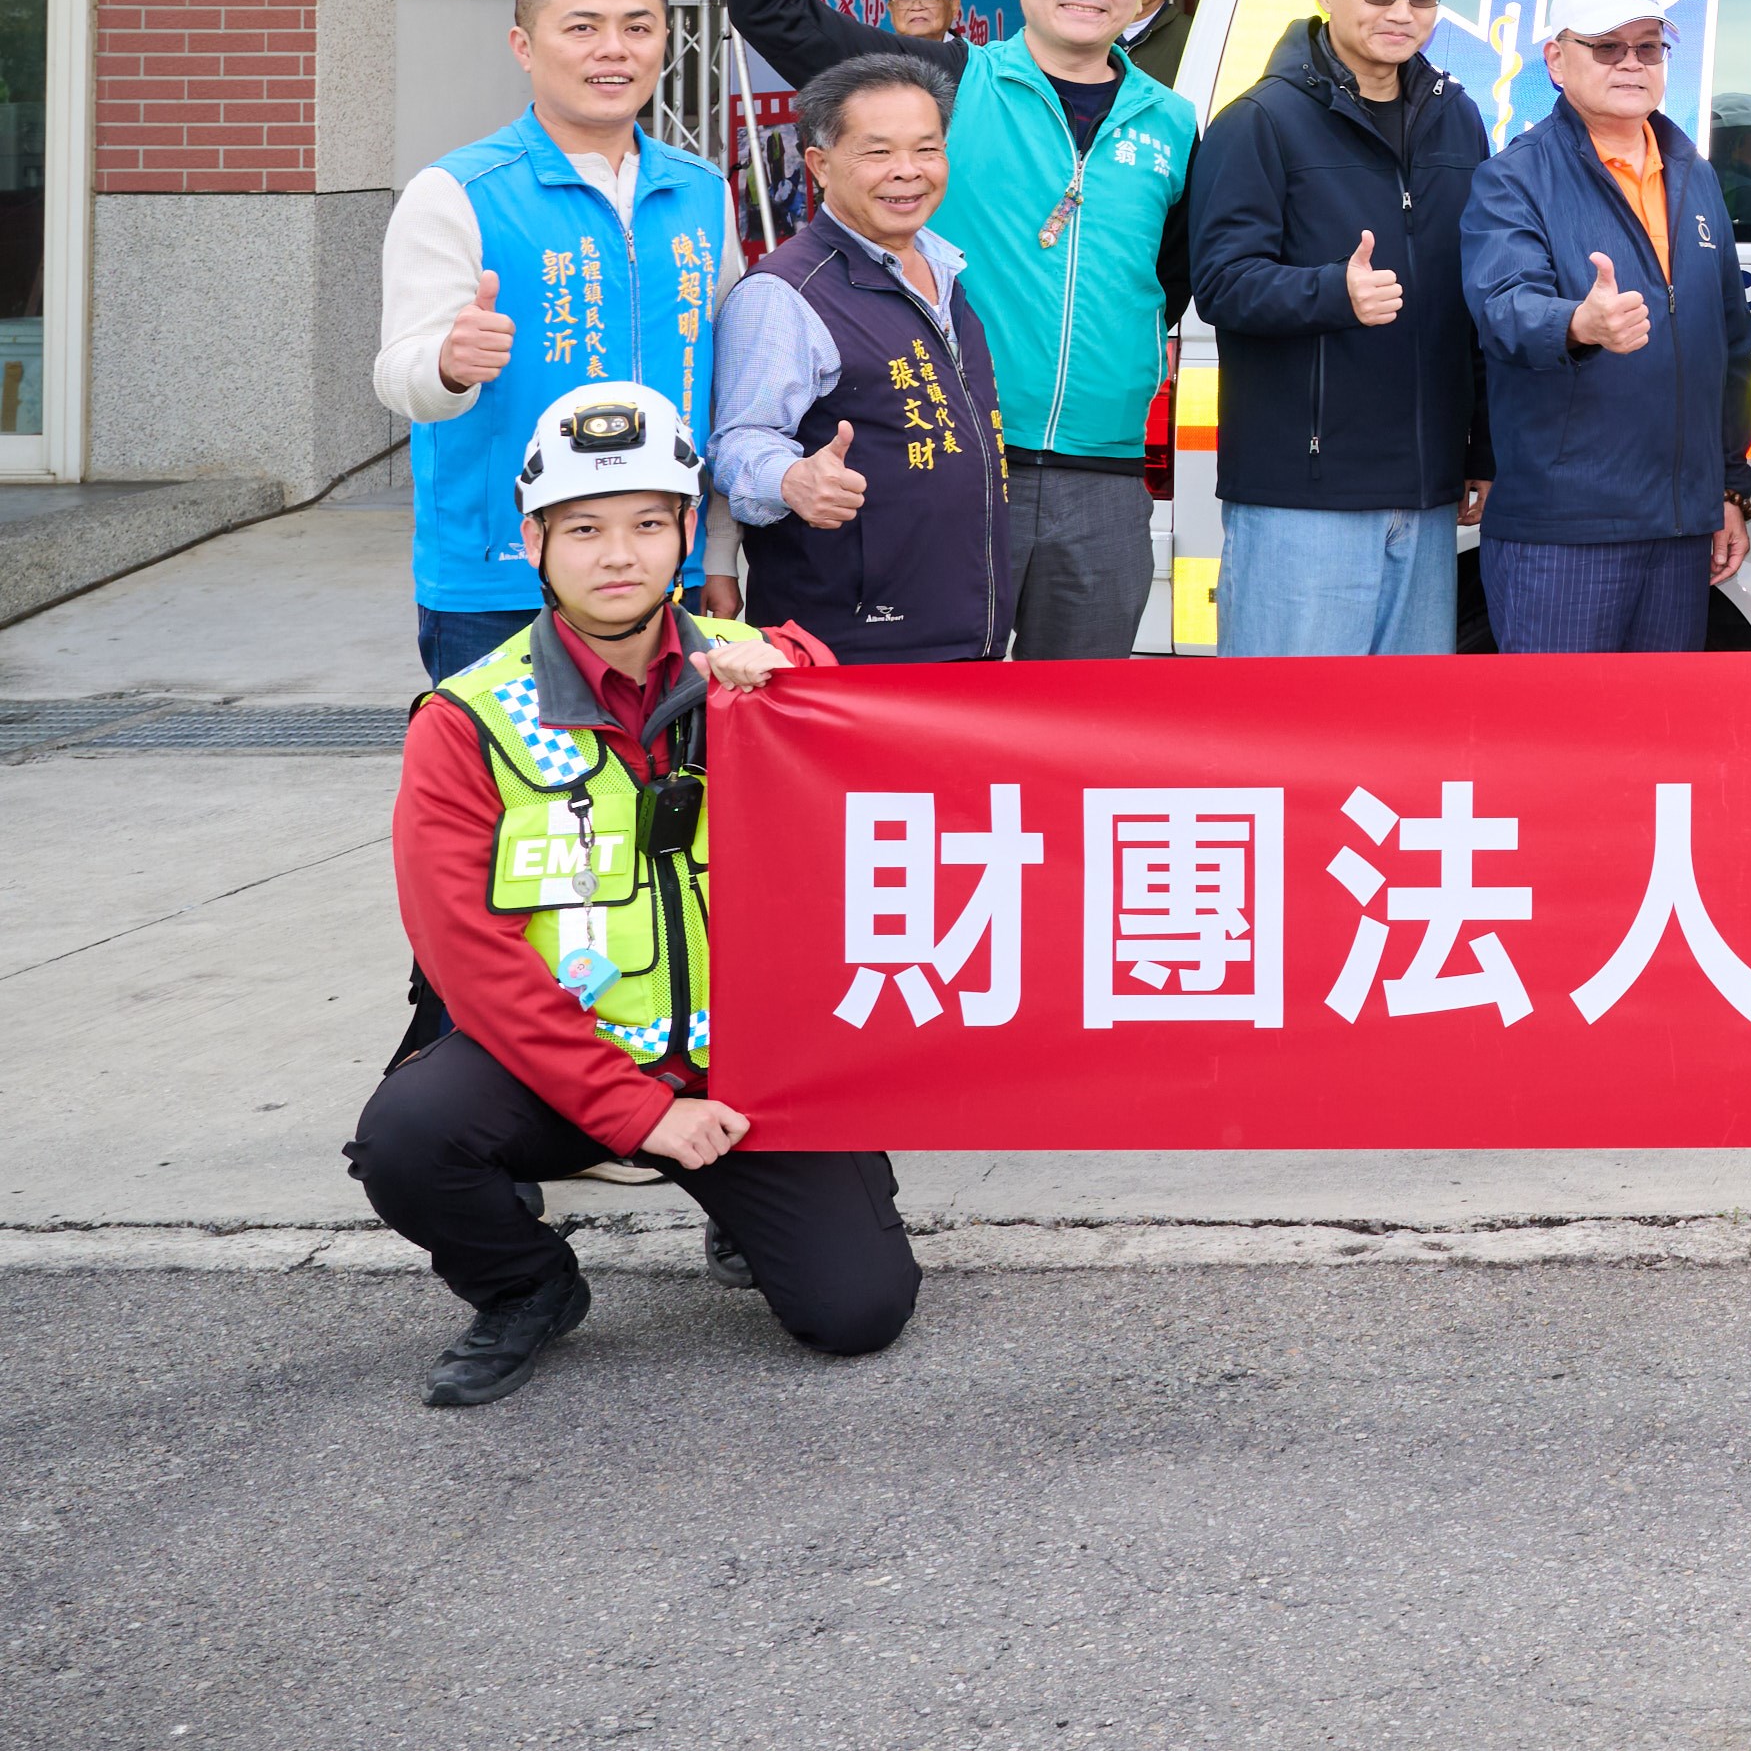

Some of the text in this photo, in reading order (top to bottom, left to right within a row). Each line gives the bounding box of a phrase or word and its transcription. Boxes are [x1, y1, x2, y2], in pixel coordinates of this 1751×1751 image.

[541, 249, 579, 365] 郭汶沂
[580, 235, 609, 379] 苑裡鎮民代表
[671, 232, 702, 344] 陳超明
[888, 357, 935, 470] 張文財
[911, 338, 963, 454] 苑裡鎮代表
[595, 456, 628, 470] PETZL
[512, 835, 624, 878] EMT
